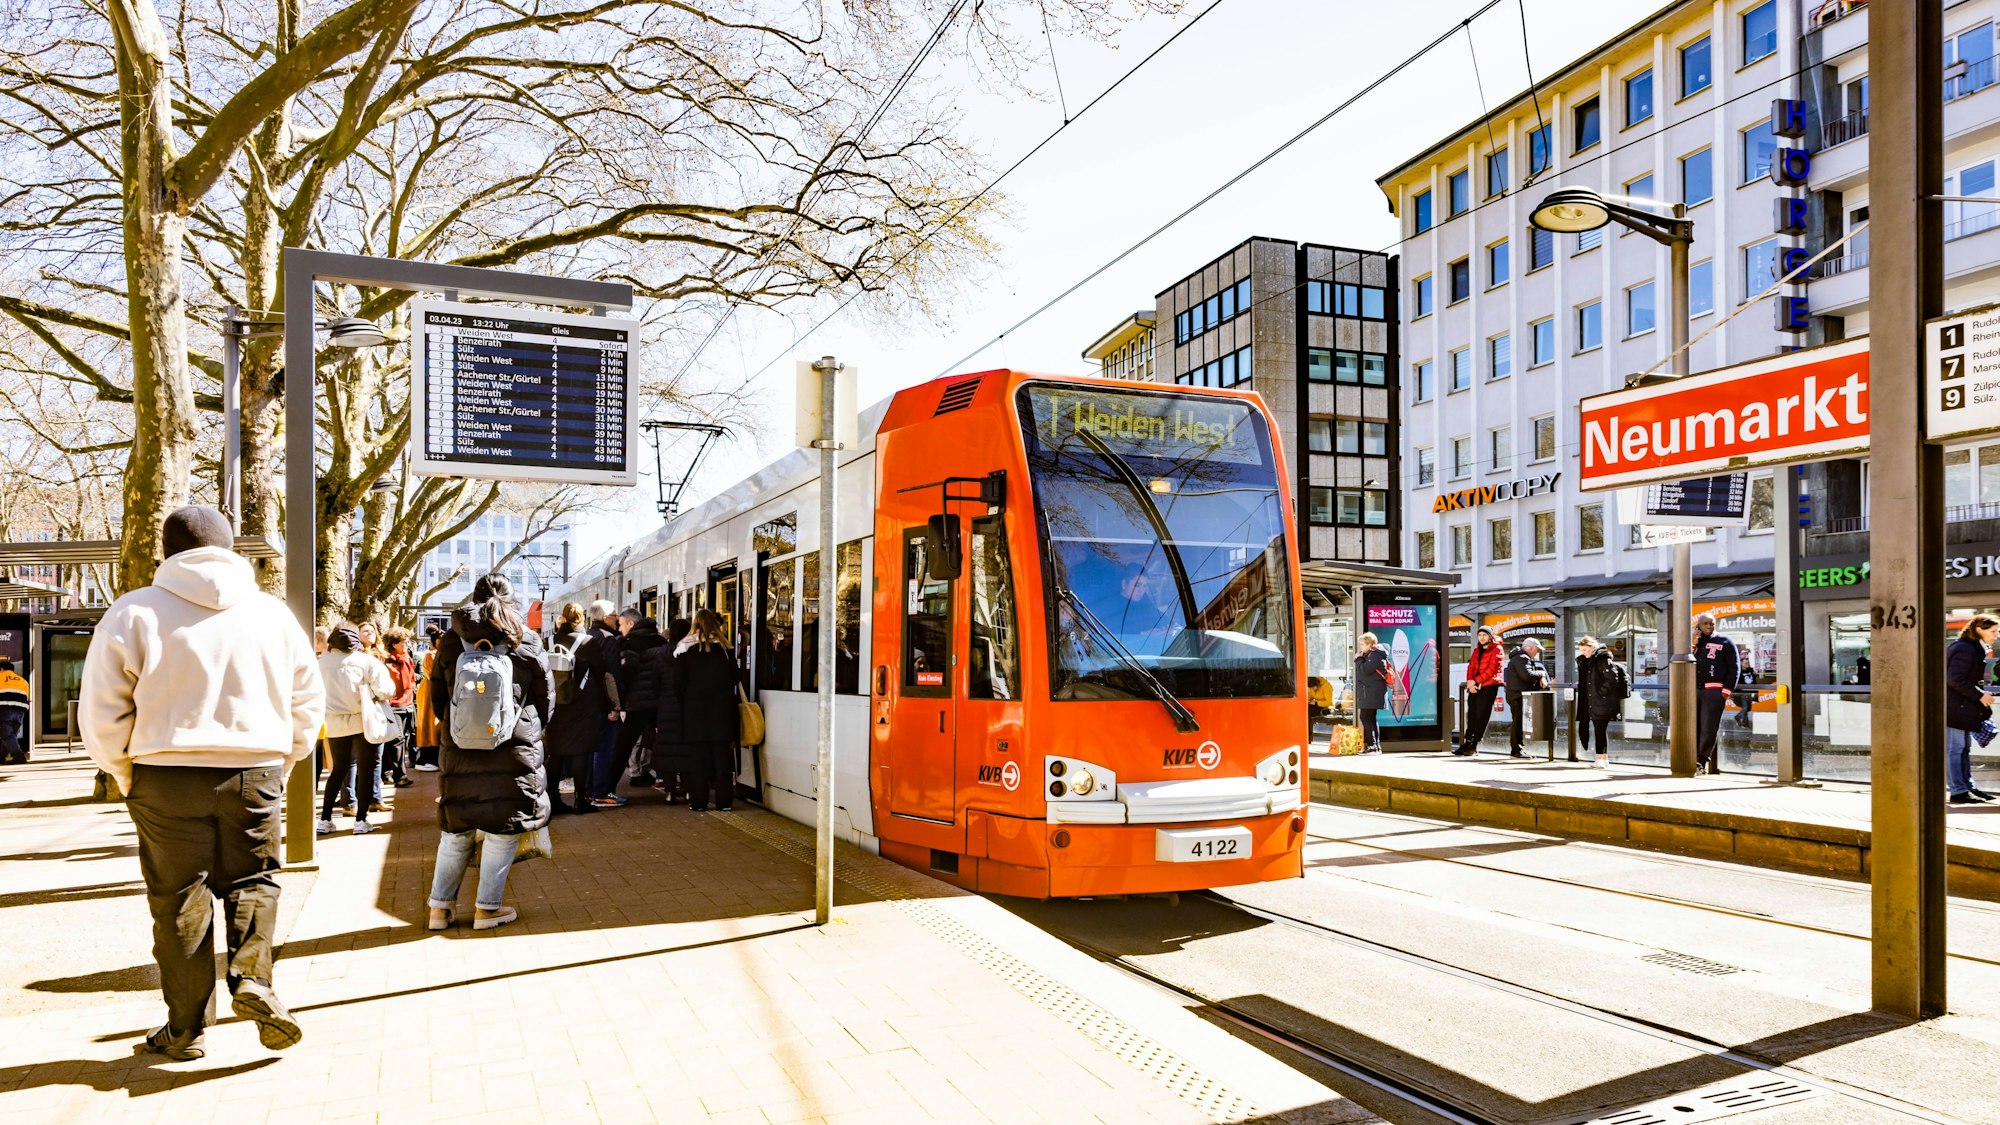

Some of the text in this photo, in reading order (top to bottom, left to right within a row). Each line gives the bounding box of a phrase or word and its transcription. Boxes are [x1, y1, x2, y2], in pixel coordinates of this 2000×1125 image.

[1785, 100, 1810, 351] HÖRGE
[430, 315, 462, 325] 03.04.23
[473, 320, 493, 328] 13:22
[552, 327, 570, 335] Gleis
[458, 328, 490, 337] Weiden
[493, 331, 513, 340] West
[599, 342, 623, 350] Sofort
[458, 337, 502, 347] Benzelrath
[1946, 328, 1956, 346] 1
[457, 345, 474, 353] Sülz
[457, 361, 474, 370] Sülz
[458, 354, 490, 363] Weiden
[492, 356, 512, 365] West
[1946, 358, 1960, 377] 7
[457, 370, 497, 380] Aachener
[499, 374, 541, 384] Str./Gürtel
[458, 379, 490, 388] Weiden
[492, 382, 512, 390] West
[458, 388, 502, 397] Benzelrath
[1946, 389, 1960, 408] 9
[458, 396, 490, 405] Weiden
[457, 404, 497, 414] Aachener
[499, 407, 541, 416] Str./Gürtel
[457, 412, 474, 420] Sülz
[458, 421, 490, 430] Weiden
[1074, 402, 1164, 440] Weiden
[1175, 409, 1236, 446] West
[1584, 372, 1867, 468] Neumarkt
[458, 429, 502, 439] Benzelrath
[457, 437, 474, 446] Sülz
[458, 446, 490, 455] Weiden
[1490, 614, 1530, 634] igitaldruck
[1871, 605, 1916, 630] 343
[1503, 628, 1535, 639] STUDENTEN
[1163, 748, 1197, 766] KVB
[979, 765, 1002, 782] KVB
[1191, 840, 1237, 856] 4122
